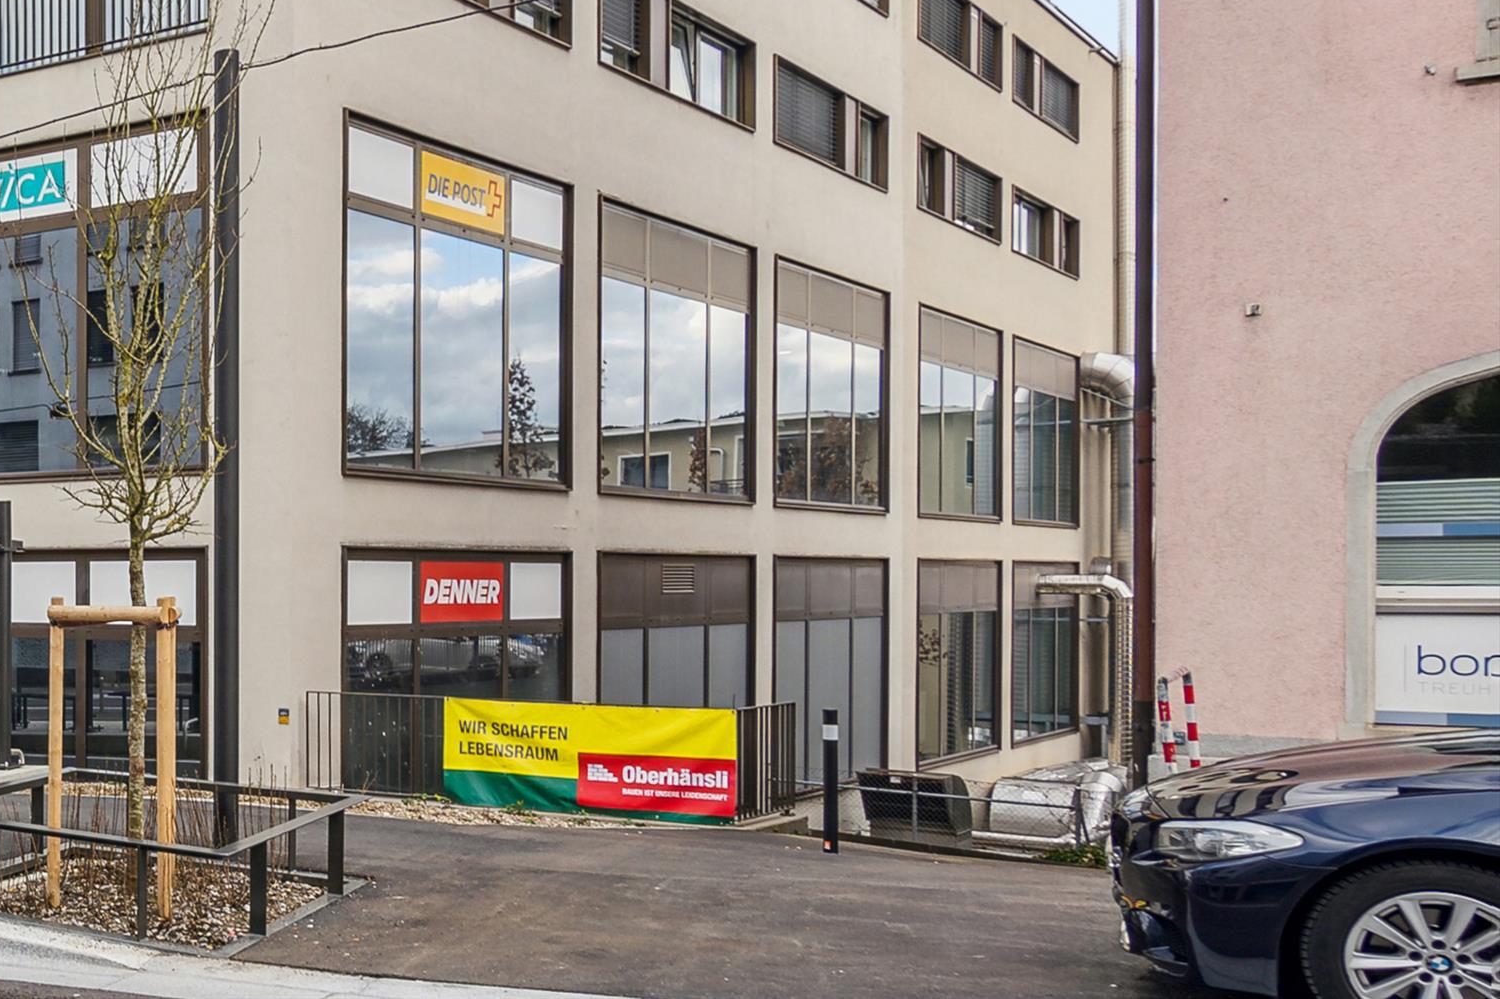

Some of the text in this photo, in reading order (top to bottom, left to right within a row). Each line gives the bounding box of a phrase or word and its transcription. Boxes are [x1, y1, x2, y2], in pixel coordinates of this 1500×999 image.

[428, 173, 486, 209] DIE POST
[423, 578, 501, 605] DENNER
[459, 720, 568, 740] WIR SCHAFFEN
[459, 741, 558, 761] LEBENSRAUM
[622, 765, 728, 789] Oberhänsli
